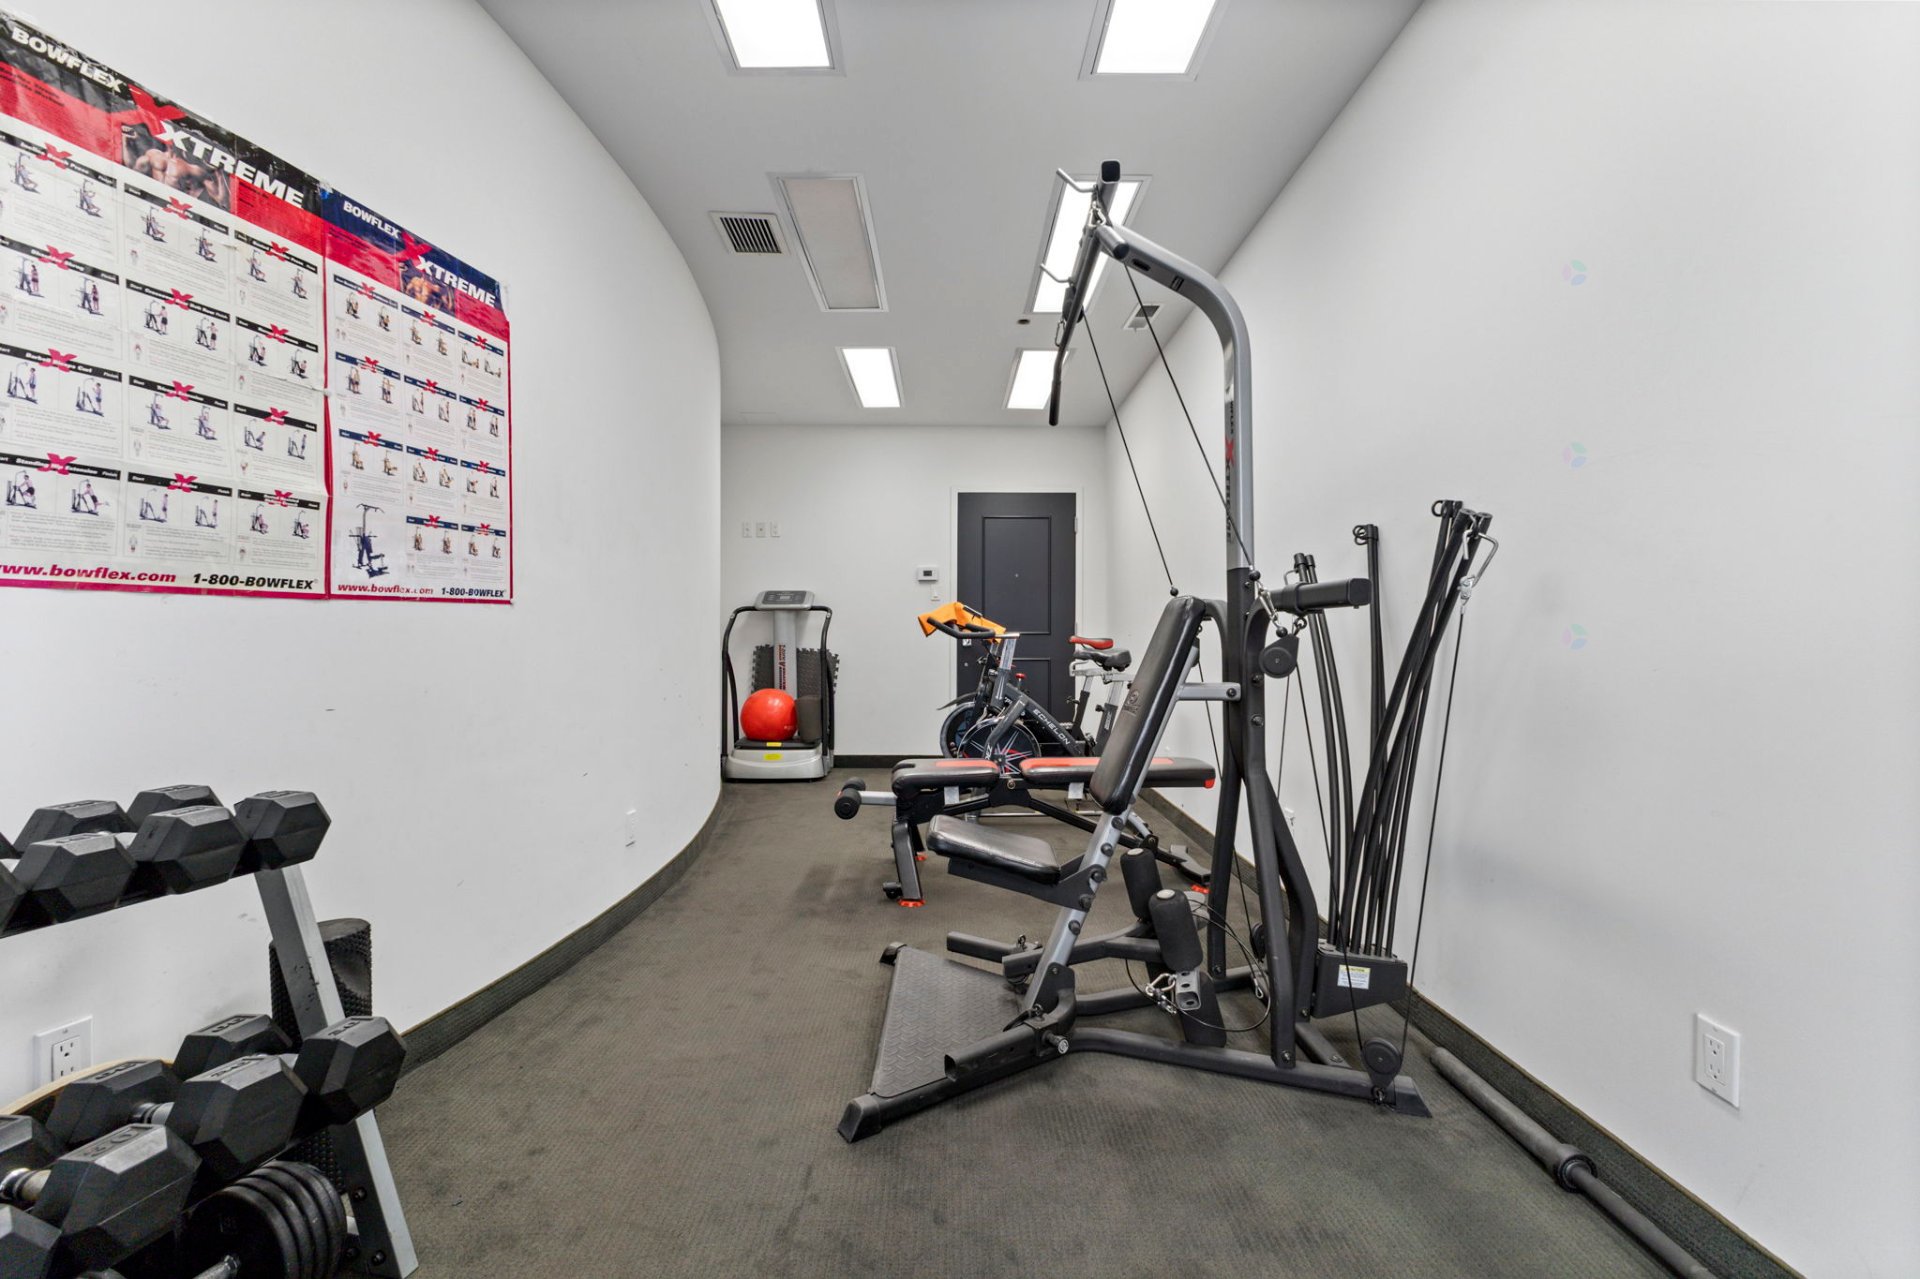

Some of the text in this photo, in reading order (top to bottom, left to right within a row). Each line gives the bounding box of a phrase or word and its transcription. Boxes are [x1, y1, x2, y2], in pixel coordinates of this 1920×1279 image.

[12, 27, 126, 93] BOWFLEX
[155, 119, 305, 208] XTREME
[343, 200, 402, 239] BOWFLEX
[415, 255, 497, 308] XTREME
[0, 564, 176, 583] ww.bowflex.com
[193, 573, 313, 590] 1-800-BOWFLEX
[441, 587, 504, 598] 1-800-BOWFLEX
[1033, 708, 1071, 745] ECHELON
